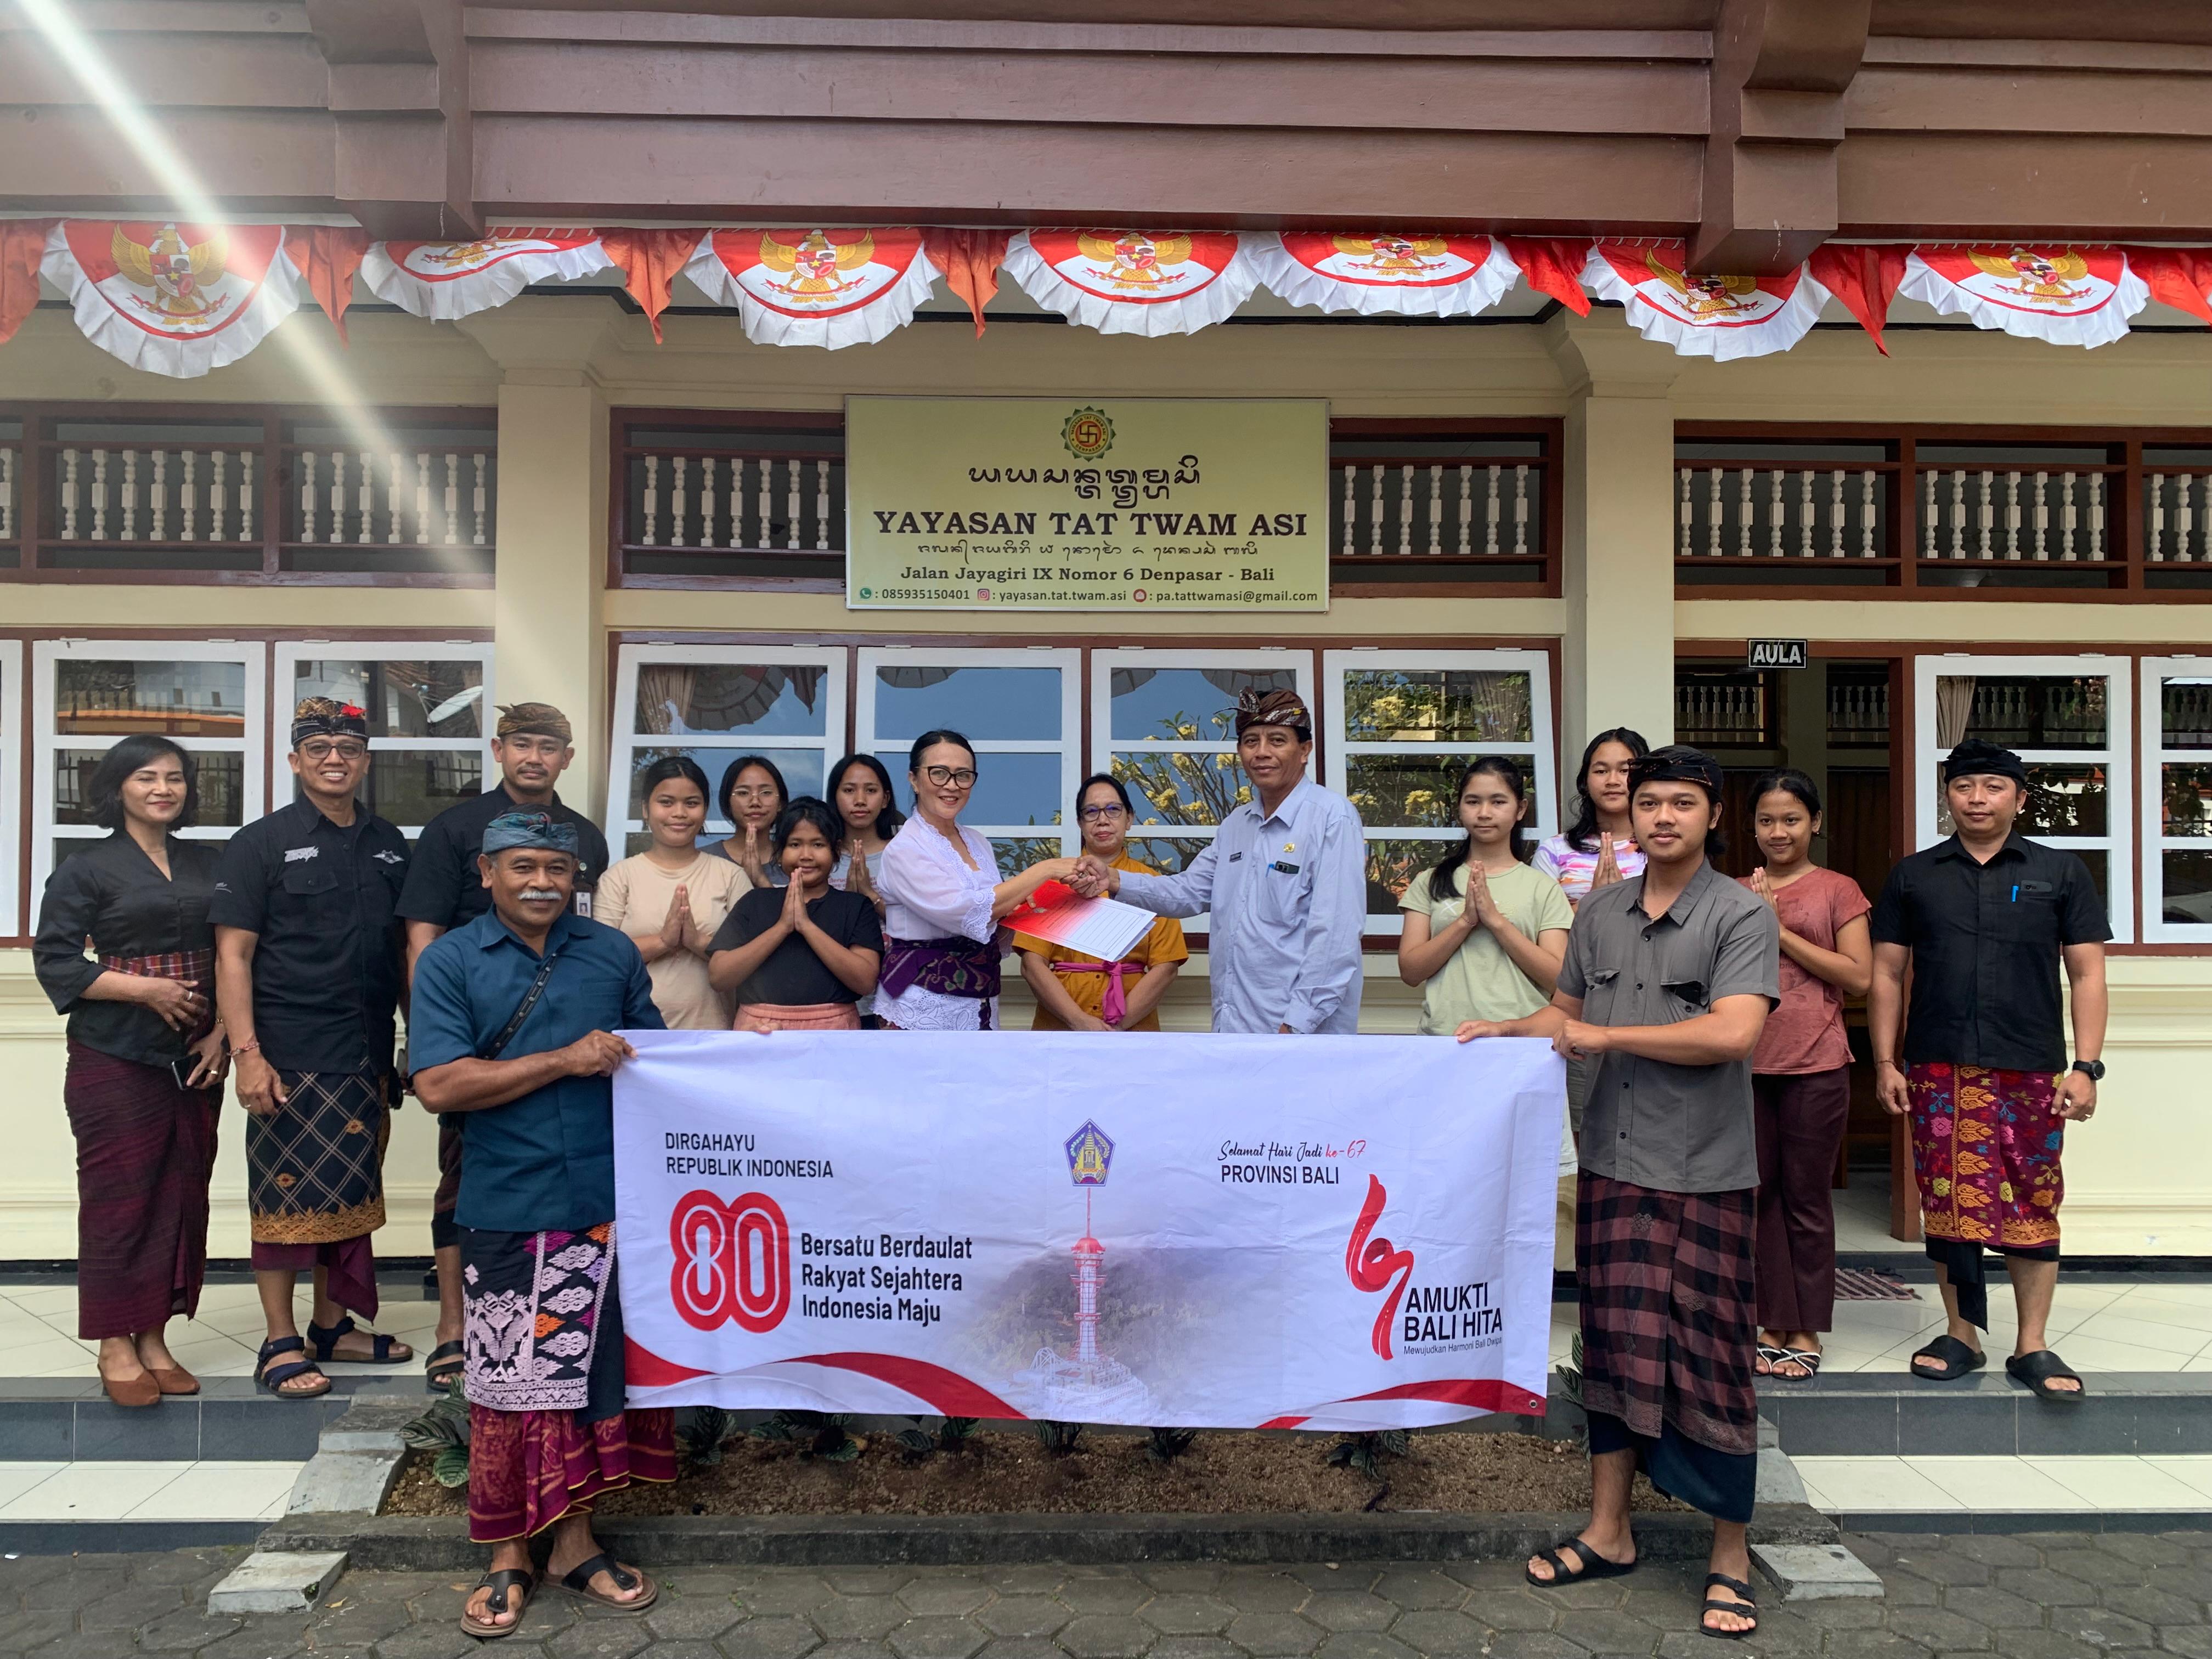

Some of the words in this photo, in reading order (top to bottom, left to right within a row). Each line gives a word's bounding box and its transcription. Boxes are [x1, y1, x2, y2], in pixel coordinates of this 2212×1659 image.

[873, 511, 1037, 534] YAYASAN
[1048, 512, 1119, 535] TAT
[1130, 512, 1237, 535] TWAM
[1249, 514, 1307, 536] ASI
[901, 567, 949, 579] Jalan
[955, 567, 1026, 583] Jayagiri
[1032, 568, 1053, 580] IX
[1059, 568, 1118, 580] Nomor
[1123, 568, 1134, 580] 6
[1140, 568, 1223, 584] Denpasar
[1240, 568, 1274, 580] Bali
[882, 589, 970, 600] 085935150401
[1000, 590, 1126, 602] yayasan.tat.twam.asi
[1156, 590, 1317, 603] pa.tattwamasi@gmail.com
[1753, 644, 1802, 663] AULA
[665, 1132, 754, 1152] DIRGAHAYU
[1217, 1140, 1266, 1161] Selamat
[1268, 1141, 1293, 1161] Hari
[1296, 1142, 1322, 1162] Jadi
[1325, 1139, 1366, 1158] ke-67
[667, 1156, 742, 1176] REPUBLIK
[747, 1159, 833, 1178] INDONESIA
[1221, 1165, 1297, 1183] PROVINSI
[1302, 1166, 1339, 1184] BALI
[801, 1233, 874, 1257] Bersatu
[881, 1234, 972, 1259] Berdaulat
[670, 1189, 790, 1333] 80
[802, 1263, 865, 1289] Rakyat
[871, 1266, 962, 1295] Sejahtera
[1405, 1282, 1488, 1313] AMUKTI
[803, 1294, 892, 1321] Indonesia
[898, 1298, 940, 1327] Maju
[1404, 1314, 1457, 1342] BALI
[1463, 1307, 1502, 1338] HITA
[1404, 1346, 1446, 1356] Mewujudkan
[1448, 1342, 1474, 1352] Harmoni
[1475, 1339, 1486, 1349] Bali
